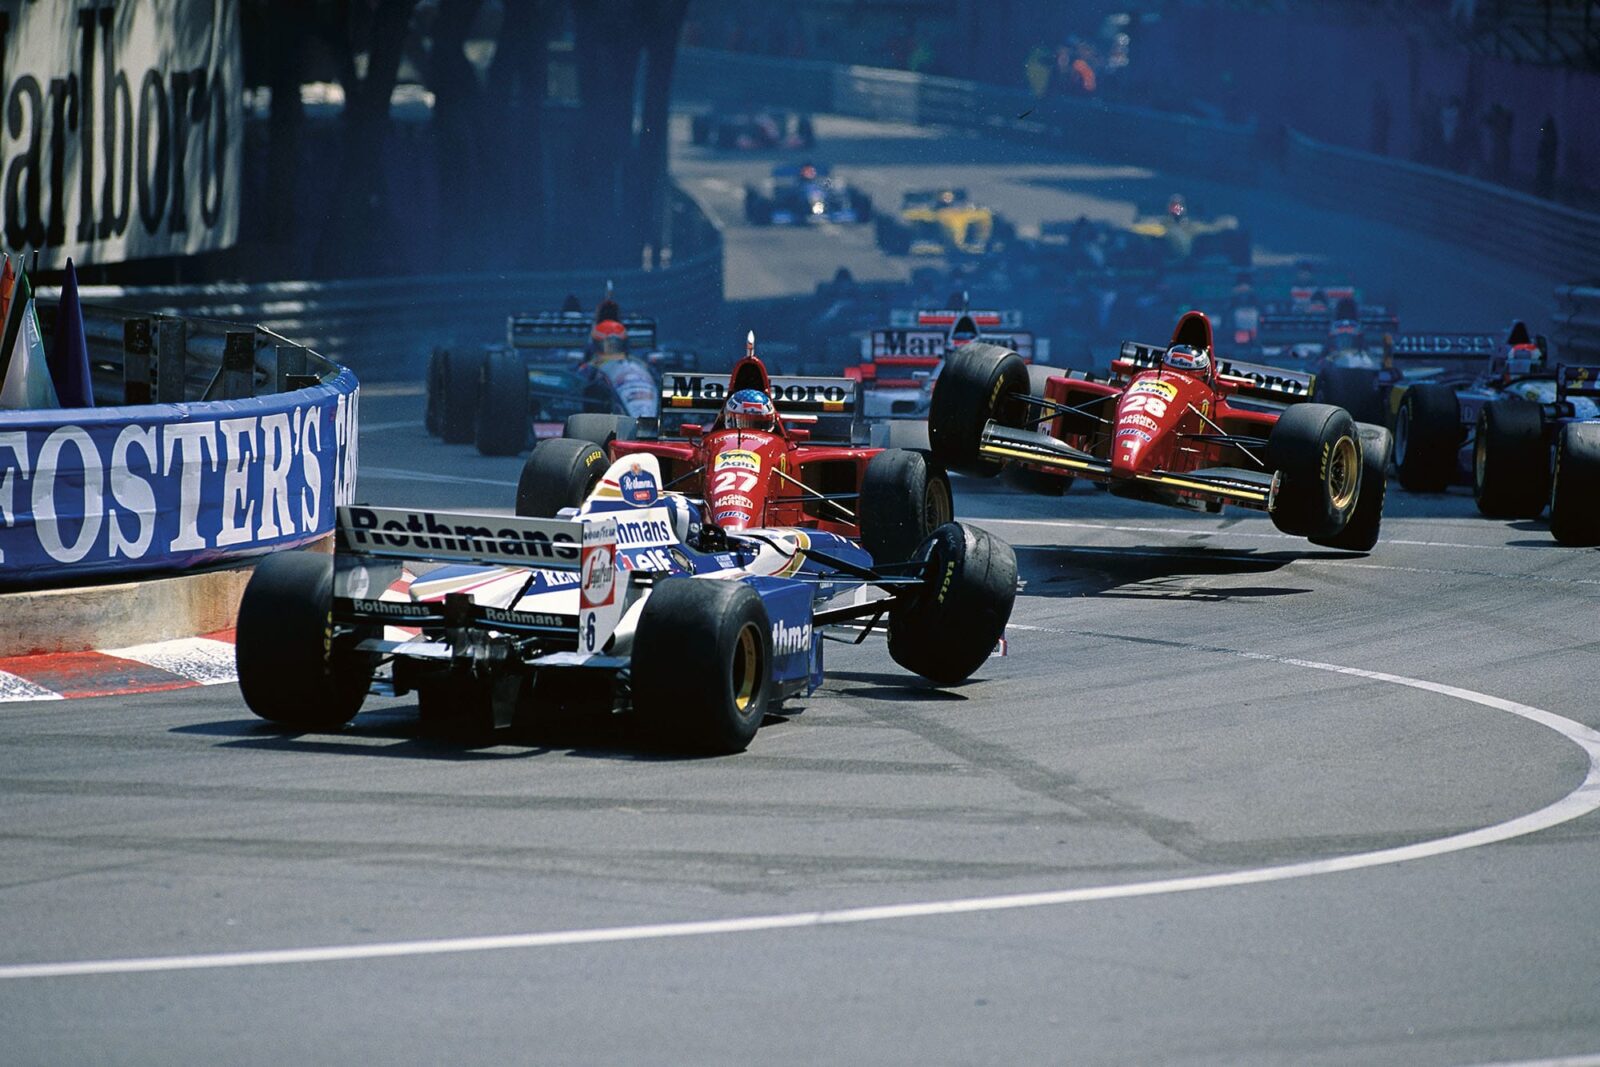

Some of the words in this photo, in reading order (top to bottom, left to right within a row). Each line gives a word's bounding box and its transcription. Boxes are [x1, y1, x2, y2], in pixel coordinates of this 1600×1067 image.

[0, 8, 227, 250] arlboro
[672, 377, 846, 400] Maboro
[1122, 396, 1167, 418] 28
[714, 472, 758, 494] 27
[350, 507, 580, 560] Rothmans
[635, 549, 671, 572] elf
[354, 600, 430, 615] Rothmans
[485, 608, 563, 626] Rothmans
[587, 611, 596, 652] 6
